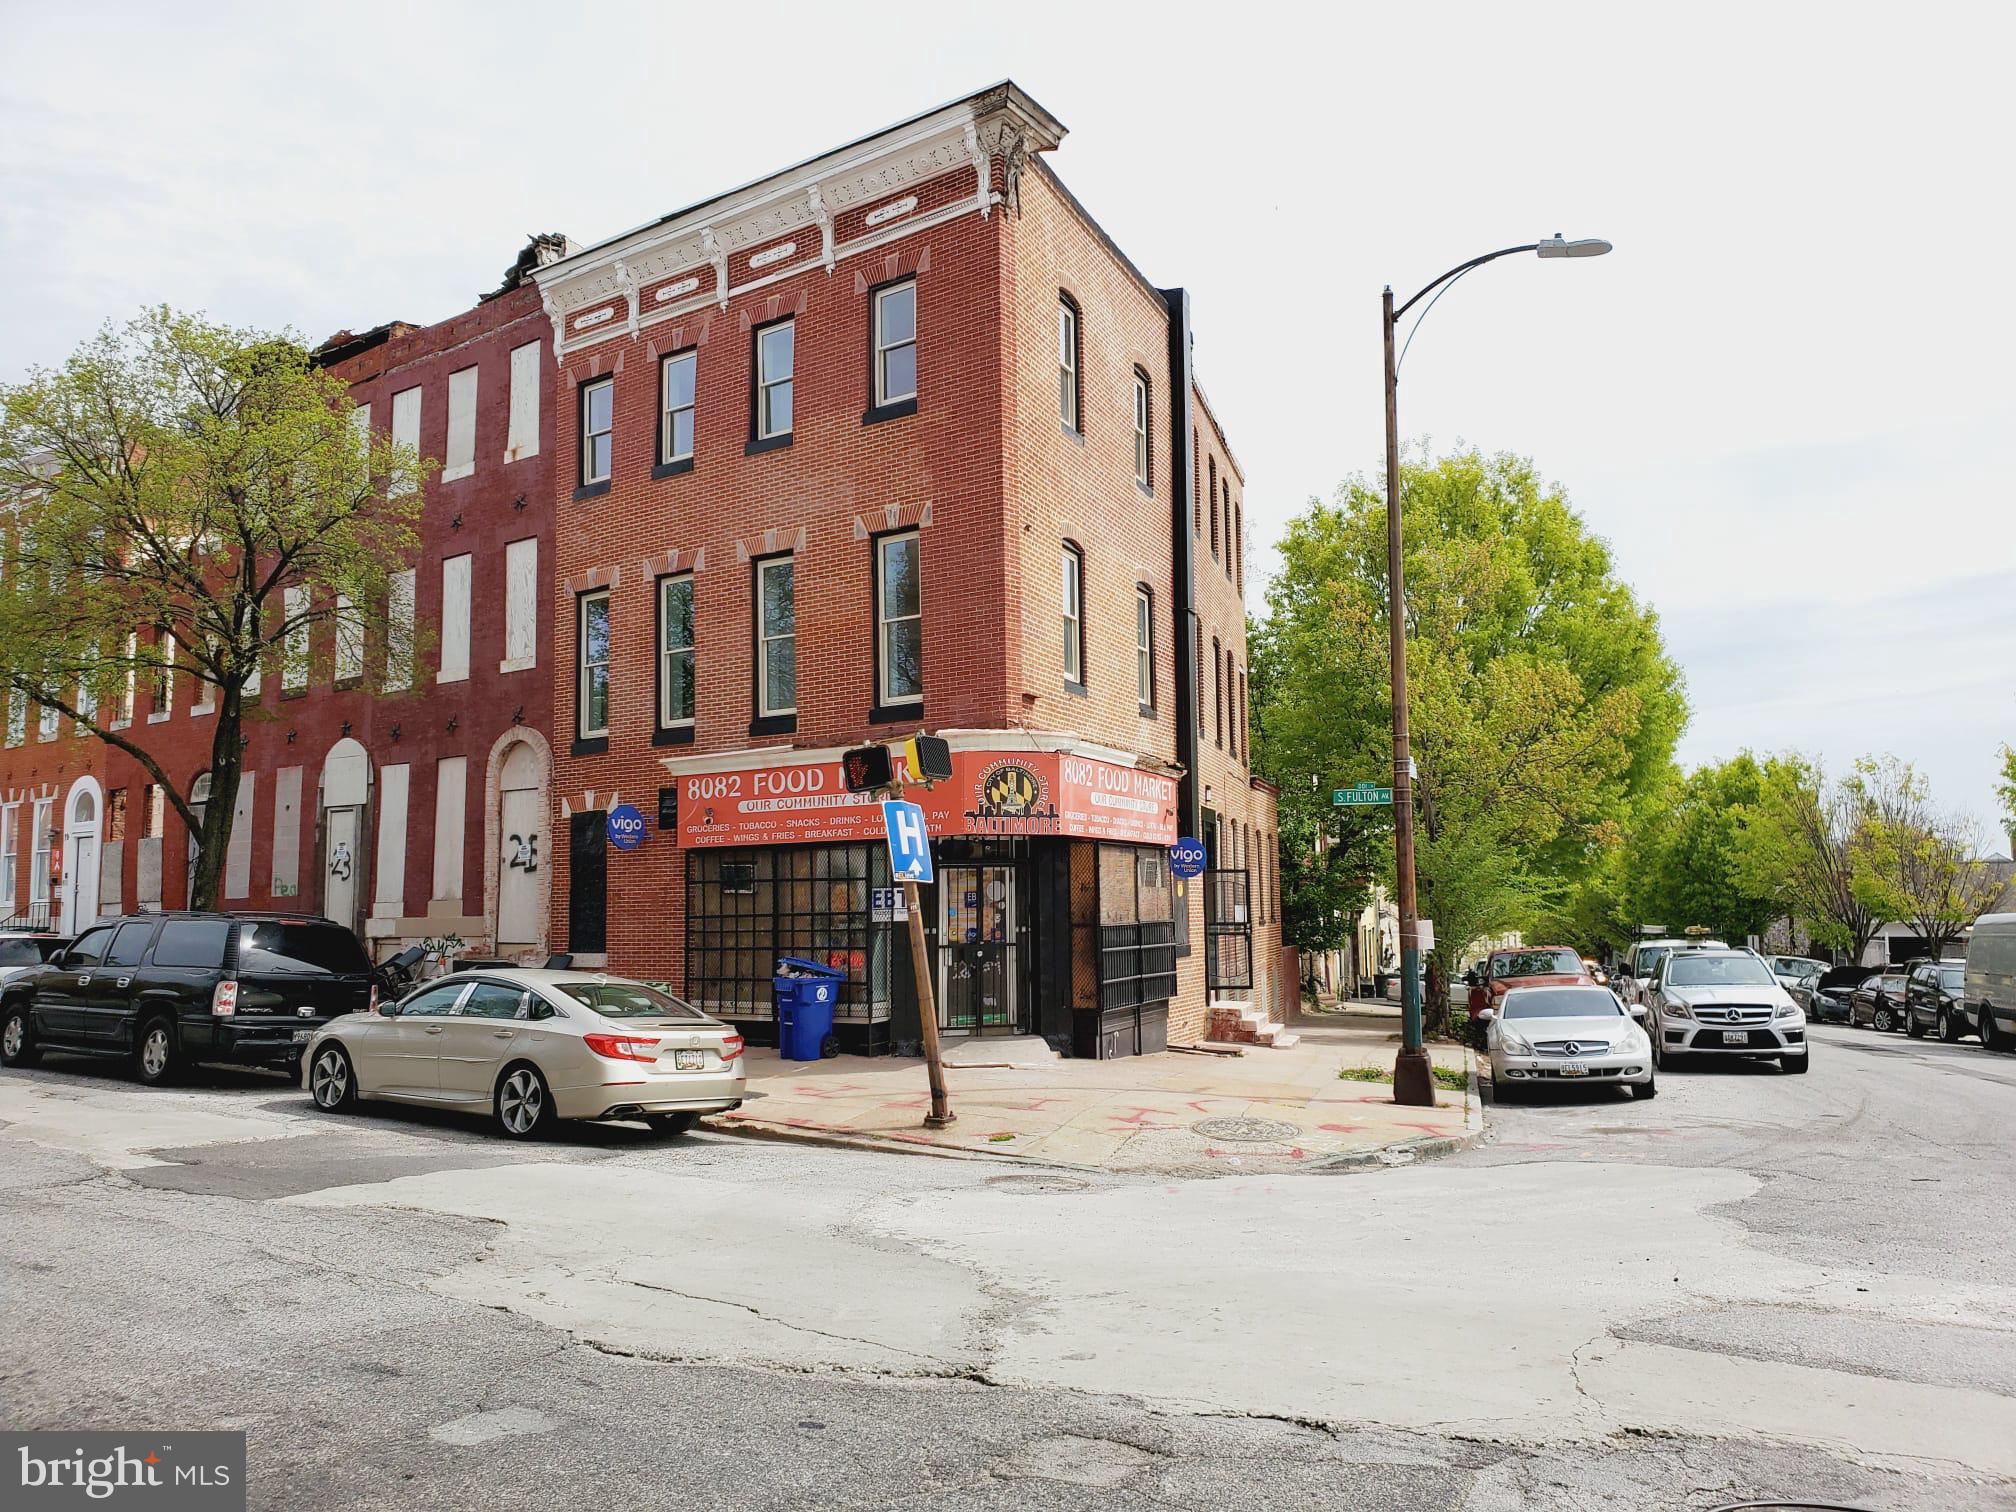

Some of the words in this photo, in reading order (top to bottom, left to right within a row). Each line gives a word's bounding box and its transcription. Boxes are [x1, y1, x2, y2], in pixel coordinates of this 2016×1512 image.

[977, 757, 1040, 780] COMMUNITY
[1005, 766, 1038, 788] BALTIMORE
[687, 775, 742, 800] 8082
[752, 768, 824, 795] FOOD
[1064, 759, 1093, 786] 8082
[1098, 767, 1129, 792] FOOD
[1134, 773, 1173, 801] MARKET
[746, 800, 771, 811] OUR
[777, 794, 847, 809] COMMUNITY
[974, 783, 986, 805] OUR
[1038, 775, 1049, 808] STORE
[611, 815, 642, 833] vigo
[686, 823, 730, 834] GROCERIES
[739, 821, 777, 830] TOBACCO
[786, 818, 820, 828] SNACKS
[830, 815, 862, 825] DRINKS
[932, 811, 950, 820] PAY
[896, 811, 924, 856] H
[962, 816, 1061, 834] BALTIMORE
[695, 835, 725, 844] COFFEE
[733, 833, 760, 842] WINGS
[762, 832, 768, 840] &
[772, 831, 795, 840] FRIES
[805, 828, 853, 838] BREAKFAST
[1170, 846, 1203, 863] vigo
